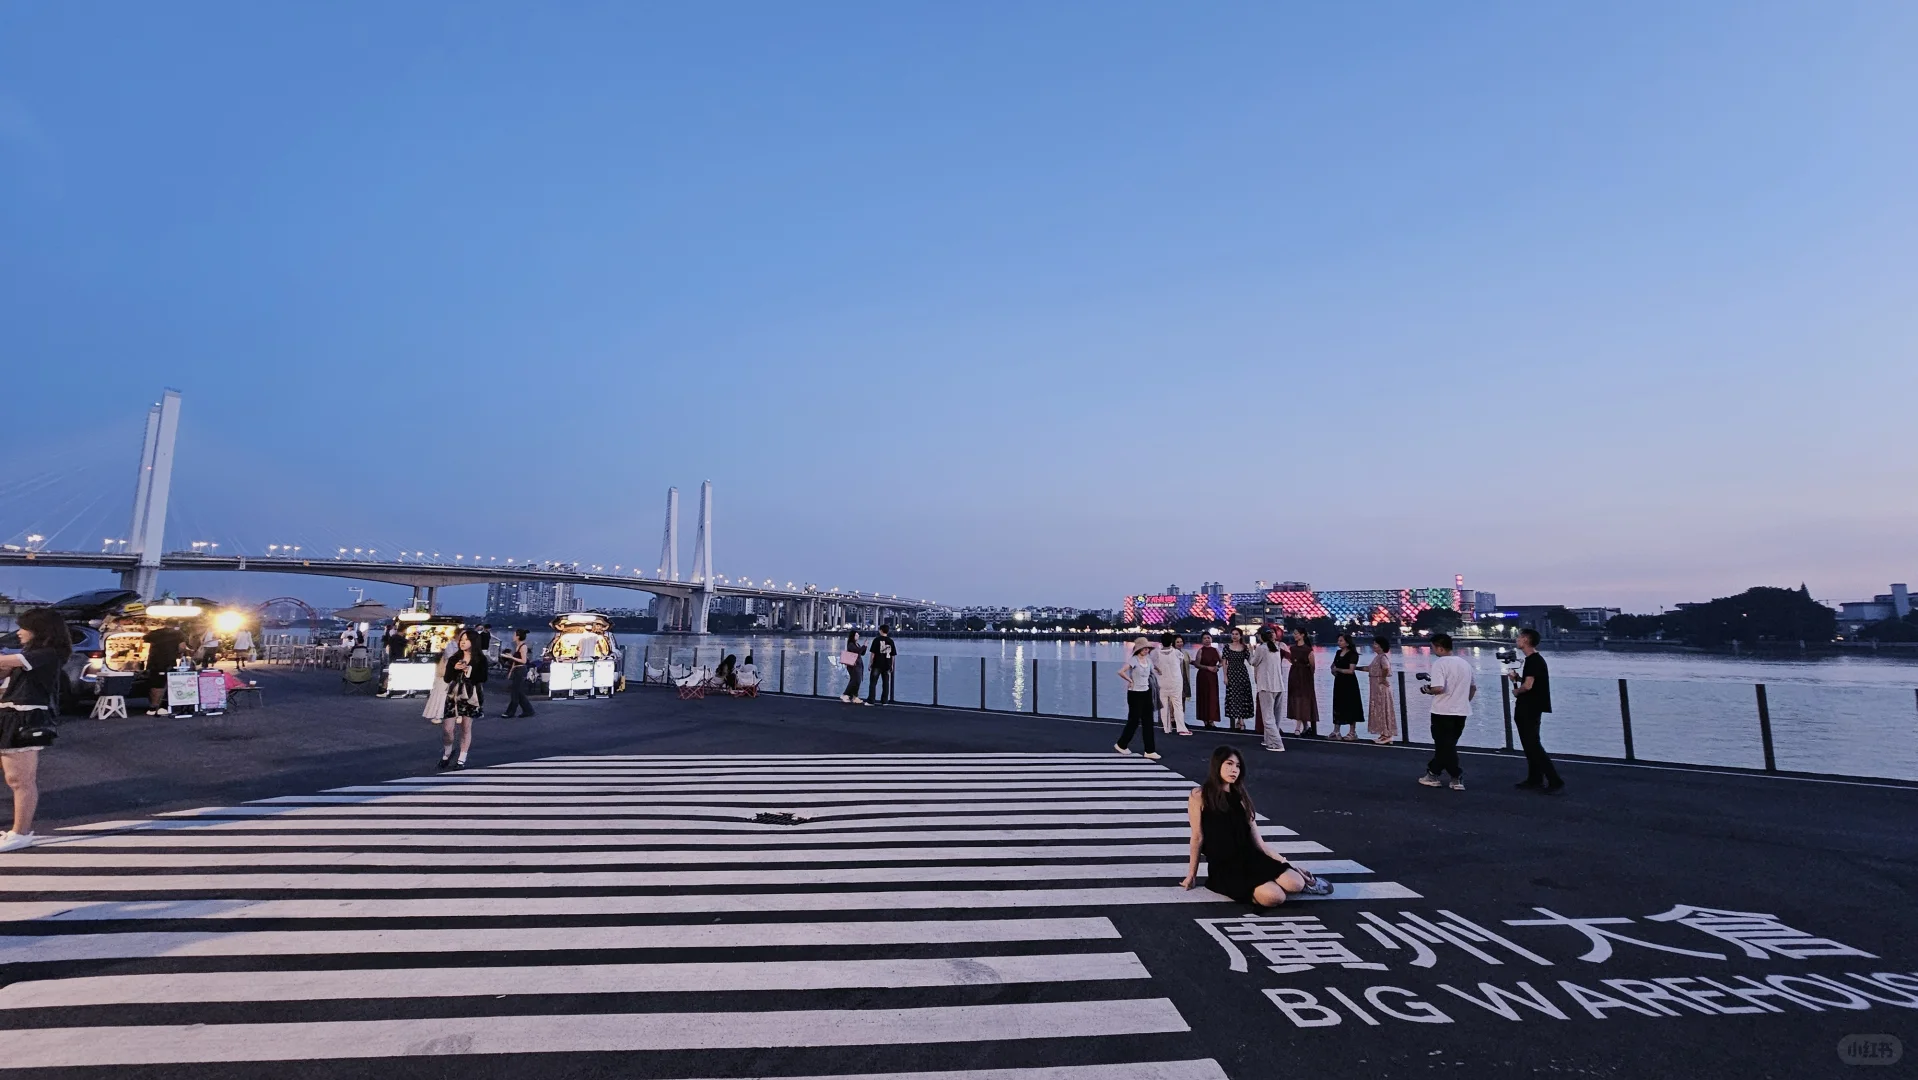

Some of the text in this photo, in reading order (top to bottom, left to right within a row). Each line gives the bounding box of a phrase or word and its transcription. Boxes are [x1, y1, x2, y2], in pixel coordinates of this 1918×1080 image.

[1194, 904, 1881, 973] 廣州大倉
[1261, 986, 1455, 1028] BIG
